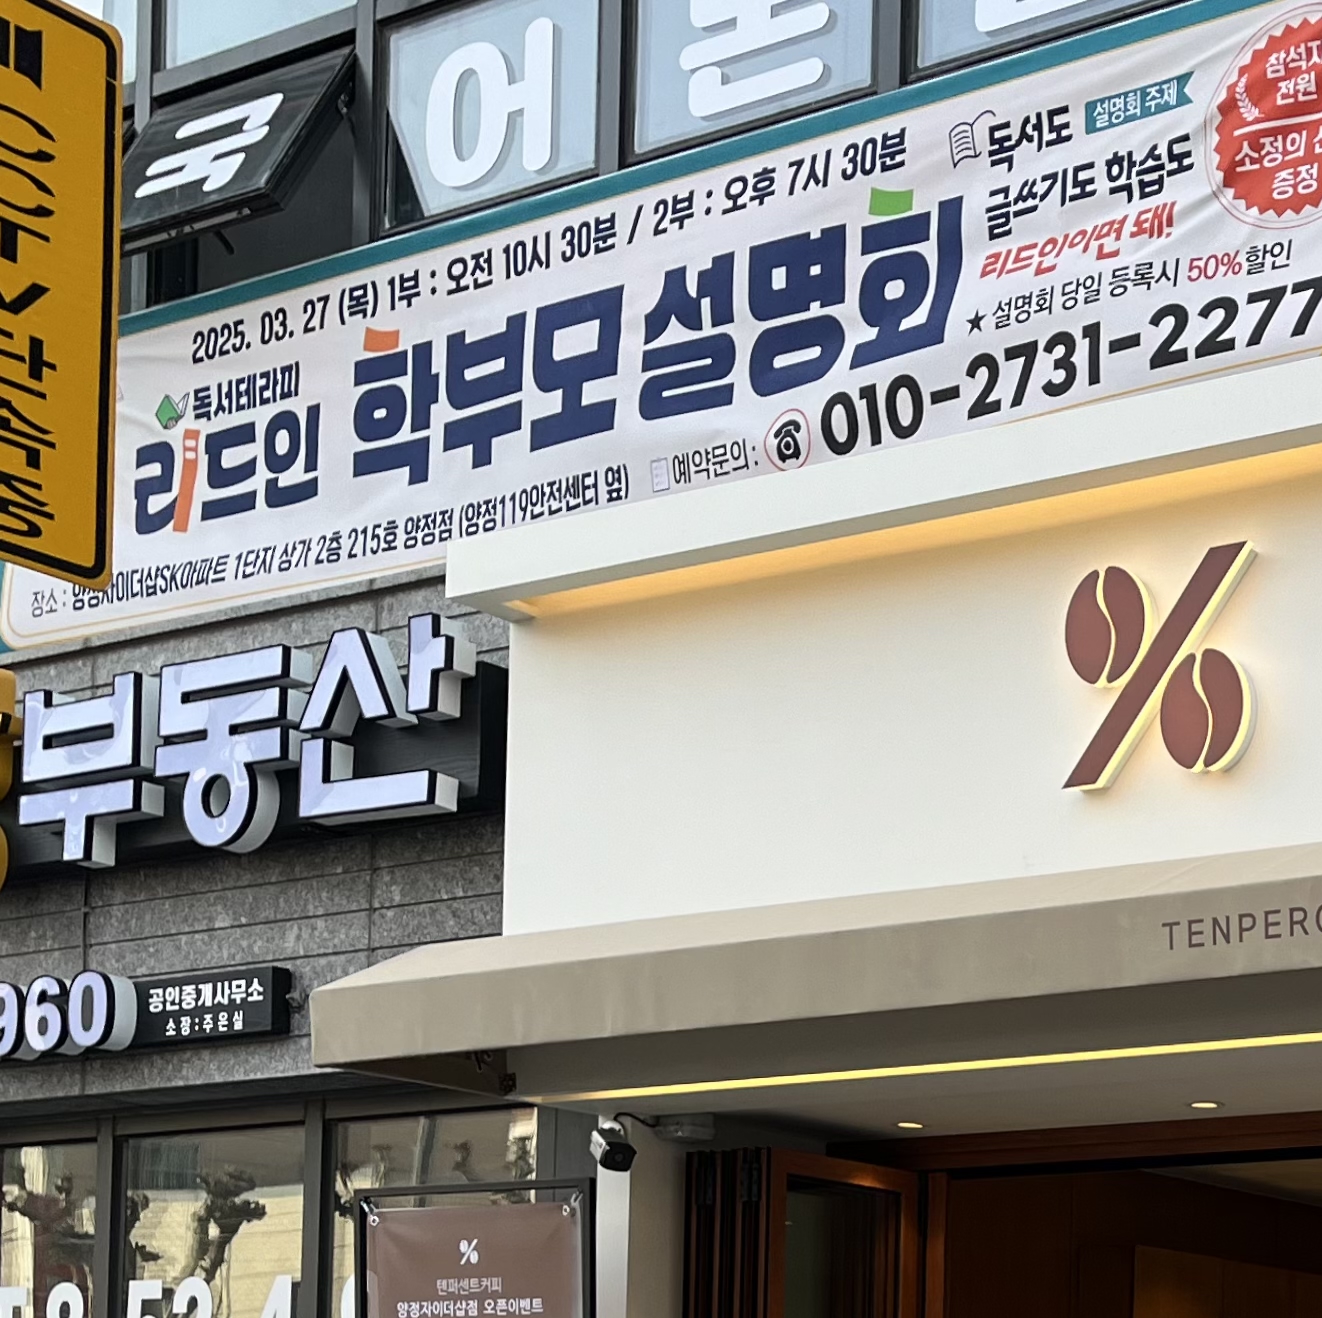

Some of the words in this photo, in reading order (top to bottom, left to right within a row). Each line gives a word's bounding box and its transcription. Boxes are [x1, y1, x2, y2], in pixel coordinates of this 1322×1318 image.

[1092, 98, 1142, 129] 설명회
[1144, 79, 1179, 111] 주제
[1275, 71, 1318, 105] 전원
[987, 105, 1074, 173] 독서도
[1234, 130, 1306, 173] 소정의
[984, 161, 1099, 242] 글쓰기도
[1105, 132, 1196, 204] 학습도
[1272, 163, 1318, 200] 증정
[191, 318, 252, 364] 2025.
[260, 306, 295, 345] 03.
[302, 293, 331, 334] 27
[338, 279, 379, 325] (목)
[387, 269, 422, 311] 1부
[446, 248, 494, 296] 오전
[502, 230, 552, 281] 10시
[560, 211, 617, 263] 30분
[652, 189, 697, 237] 2부
[720, 166, 777, 216] 오후
[786, 148, 832, 198] 7시
[841, 126, 908, 182] 30분
[979, 214, 1130, 280] 리드인이면
[1129, 201, 1178, 240] 돼!
[992, 285, 1054, 330] 설명회
[1061, 271, 1103, 311] 당일
[1108, 257, 1181, 298] 등록시
[134, 402, 322, 537] 리드인
[352, 284, 625, 487] 학부모
[639, 188, 965, 422] 설명회
[192, 361, 301, 423] 독서테라피
[233, 545, 278, 581] 1단지
[278, 537, 313, 572] 상가
[315, 529, 343, 565] 2층
[347, 519, 399, 561] 215호
[403, 507, 454, 550] 양정점
[458, 469, 599, 539] (양정119안전센터
[603, 463, 630, 503] 옆)
[18, 611, 460, 863] 부동산
[148, 977, 264, 1013] 공인중개사무소
[202, 1009, 245, 1034] 주은실
[396, 1299, 479, 1318] 양정자이더샵점
[482, 1297, 544, 1317] 오픈이벤트
[435, 1276, 503, 1296] 텐퍼센트커피
